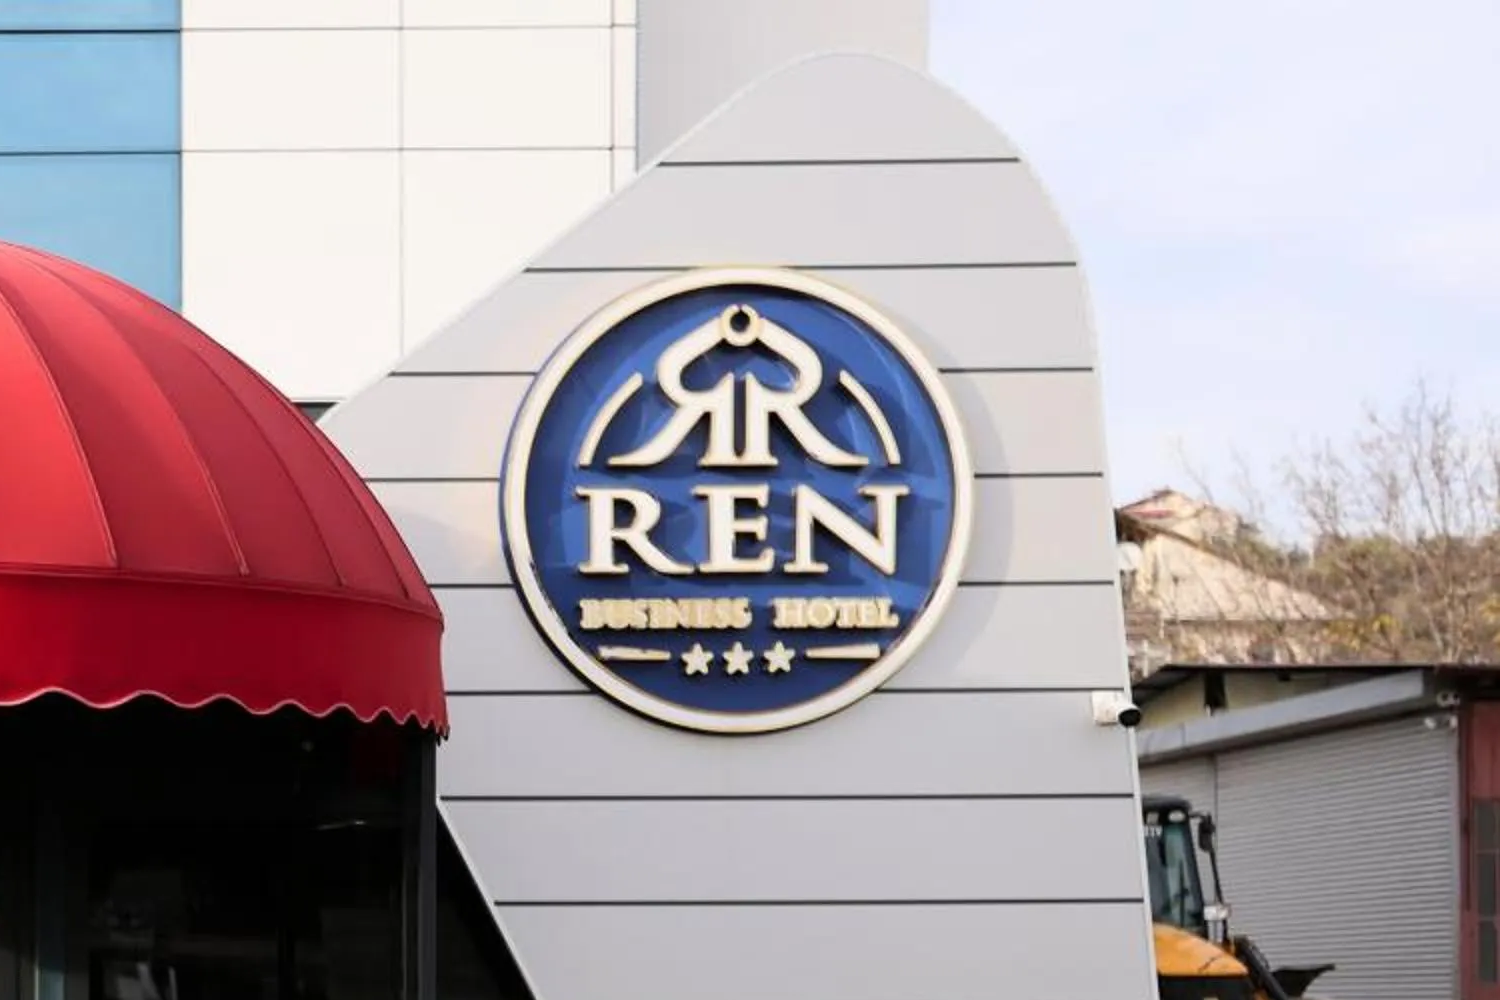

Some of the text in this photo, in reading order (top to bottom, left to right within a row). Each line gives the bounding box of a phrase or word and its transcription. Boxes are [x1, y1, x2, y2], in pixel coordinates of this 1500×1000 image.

[576, 484, 910, 576] REN
[579, 597, 899, 629] BUSINESS HOTEL
